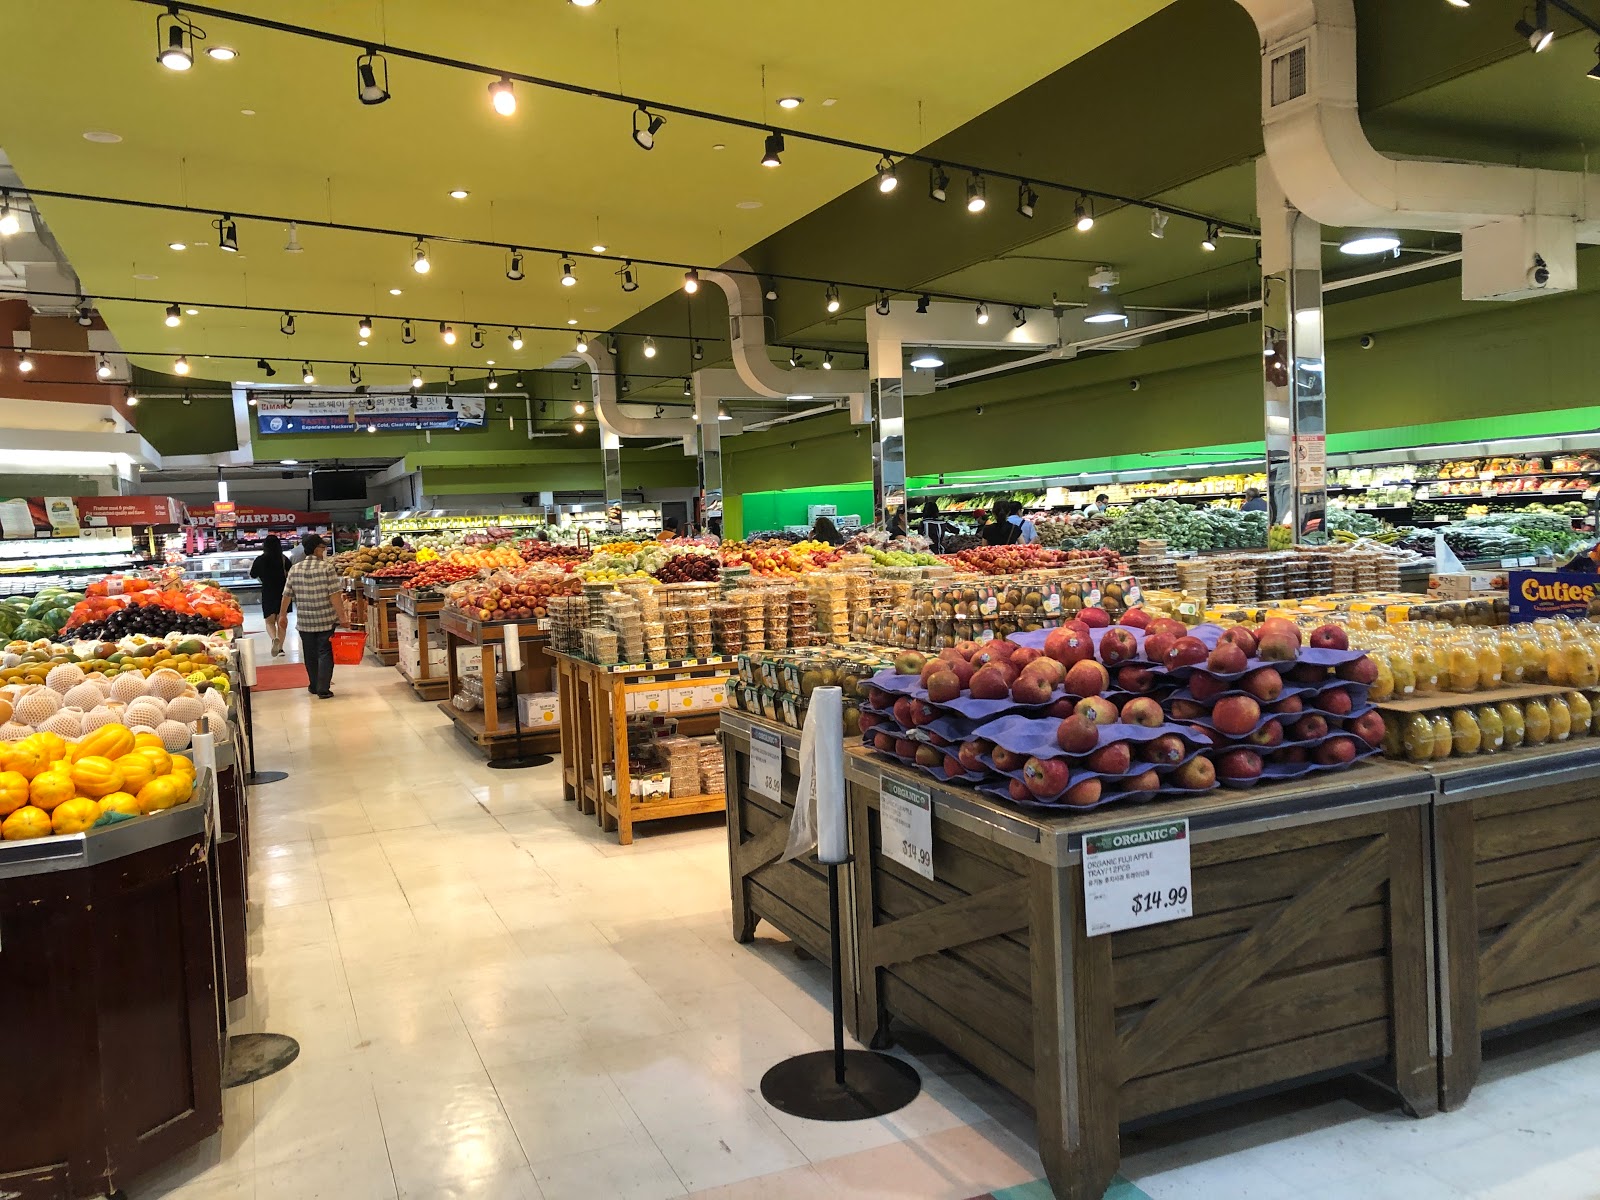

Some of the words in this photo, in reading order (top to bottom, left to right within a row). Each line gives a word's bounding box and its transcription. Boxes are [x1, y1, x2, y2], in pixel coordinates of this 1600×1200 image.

[308, 401, 344, 409] 노르웨이
[348, 397, 385, 408] 수산의
[427, 396, 438, 406] 맛!
[236, 514, 269, 524] MART
[271, 513, 296, 523] BBQ
[1521, 578, 1595, 602] Cuties
[893, 785, 920, 803] ORGANIC
[1113, 828, 1168, 847] ORGANIC
[902, 840, 931, 867] $14.99
[1087, 857, 1118, 870] ORGANIC
[1118, 855, 1133, 863] FUJI
[1133, 851, 1153, 861] APPLE
[1131, 886, 1188, 916] $14.99
